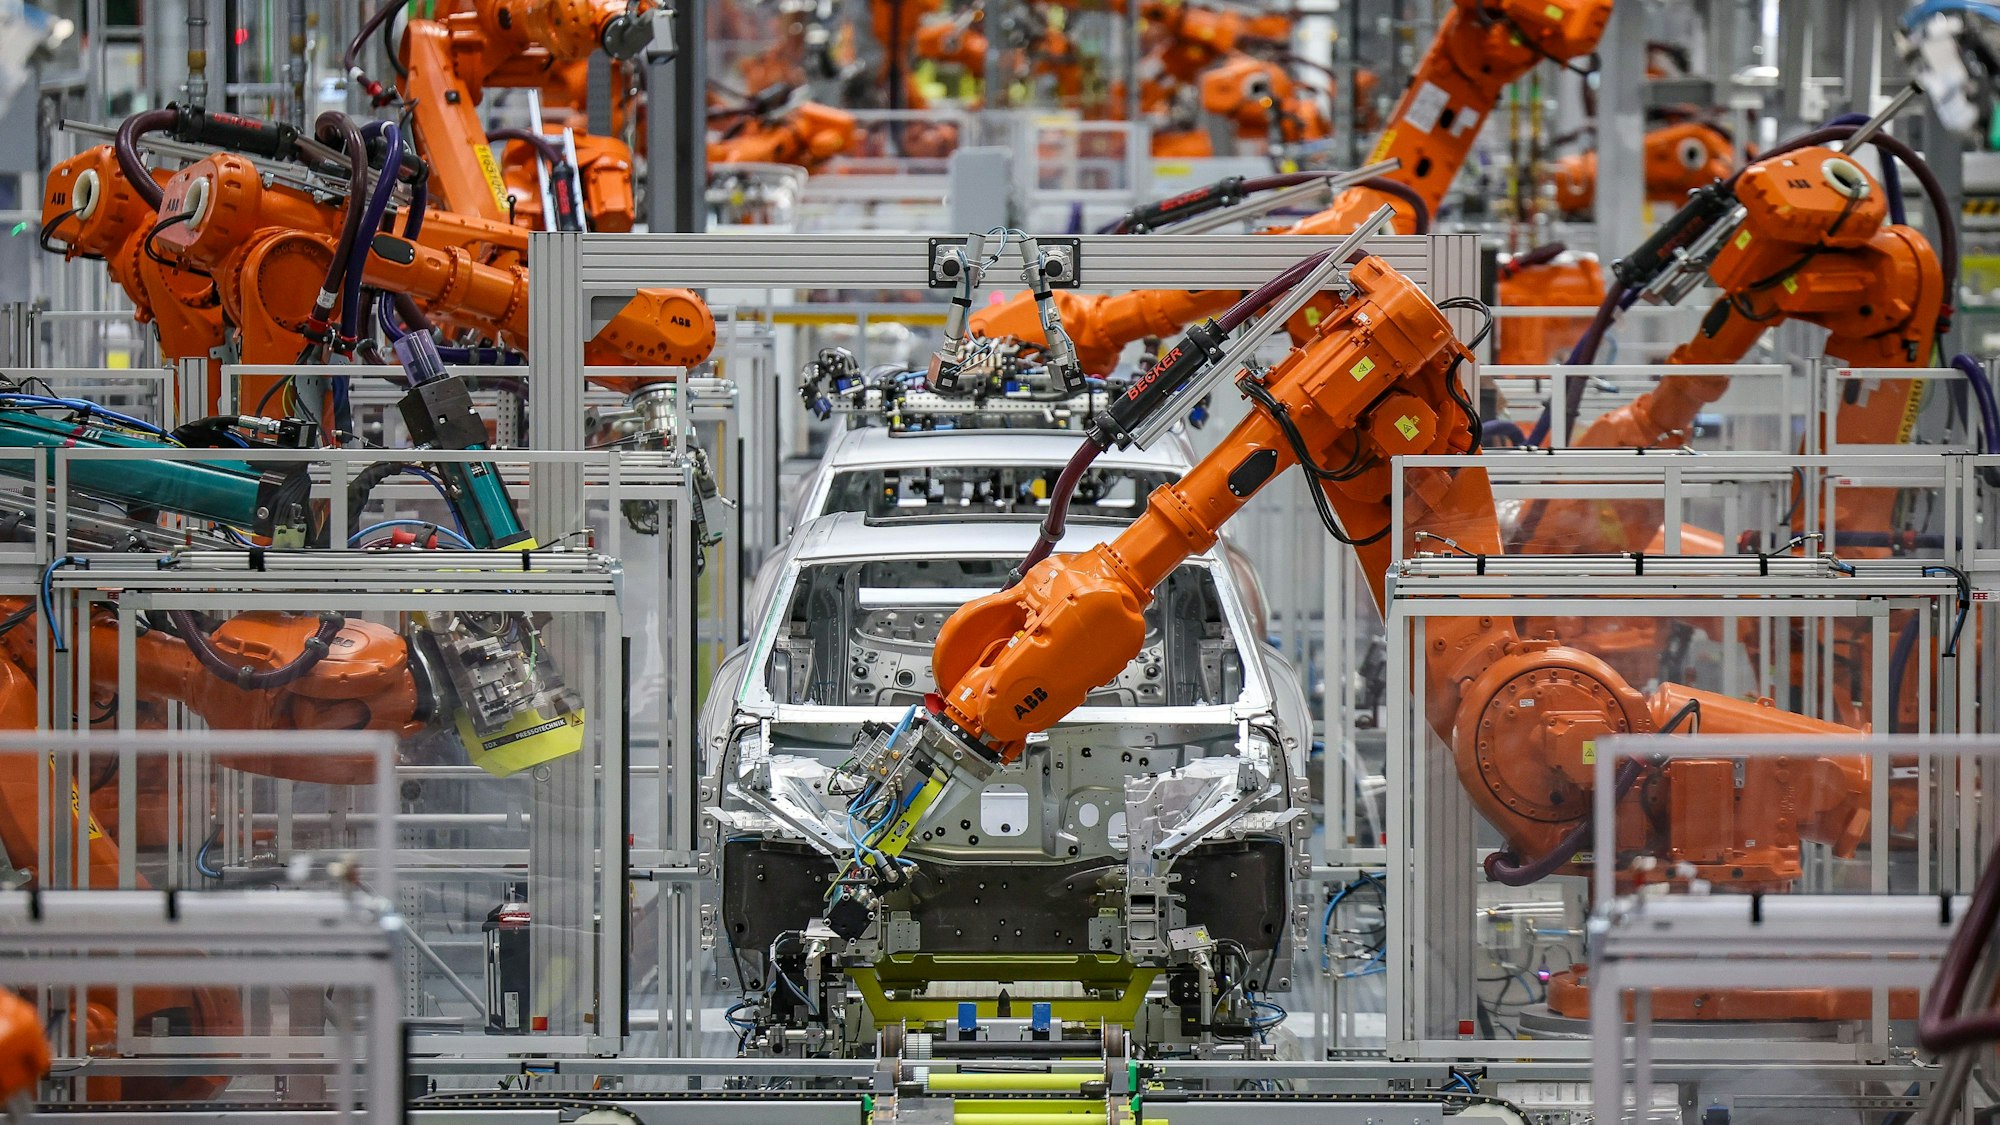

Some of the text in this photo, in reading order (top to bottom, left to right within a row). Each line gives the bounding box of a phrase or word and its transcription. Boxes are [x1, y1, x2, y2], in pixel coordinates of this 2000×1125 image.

[51, 192, 66, 206] ABB
[166, 198, 180, 212] ABB
[670, 315, 691, 328] ABB
[1127, 347, 1183, 401] BECKER
[1014, 687, 1049, 720] ABB
[484, 741, 498, 750] TOX
[515, 719, 565, 740] PRESSOTECHNIK
